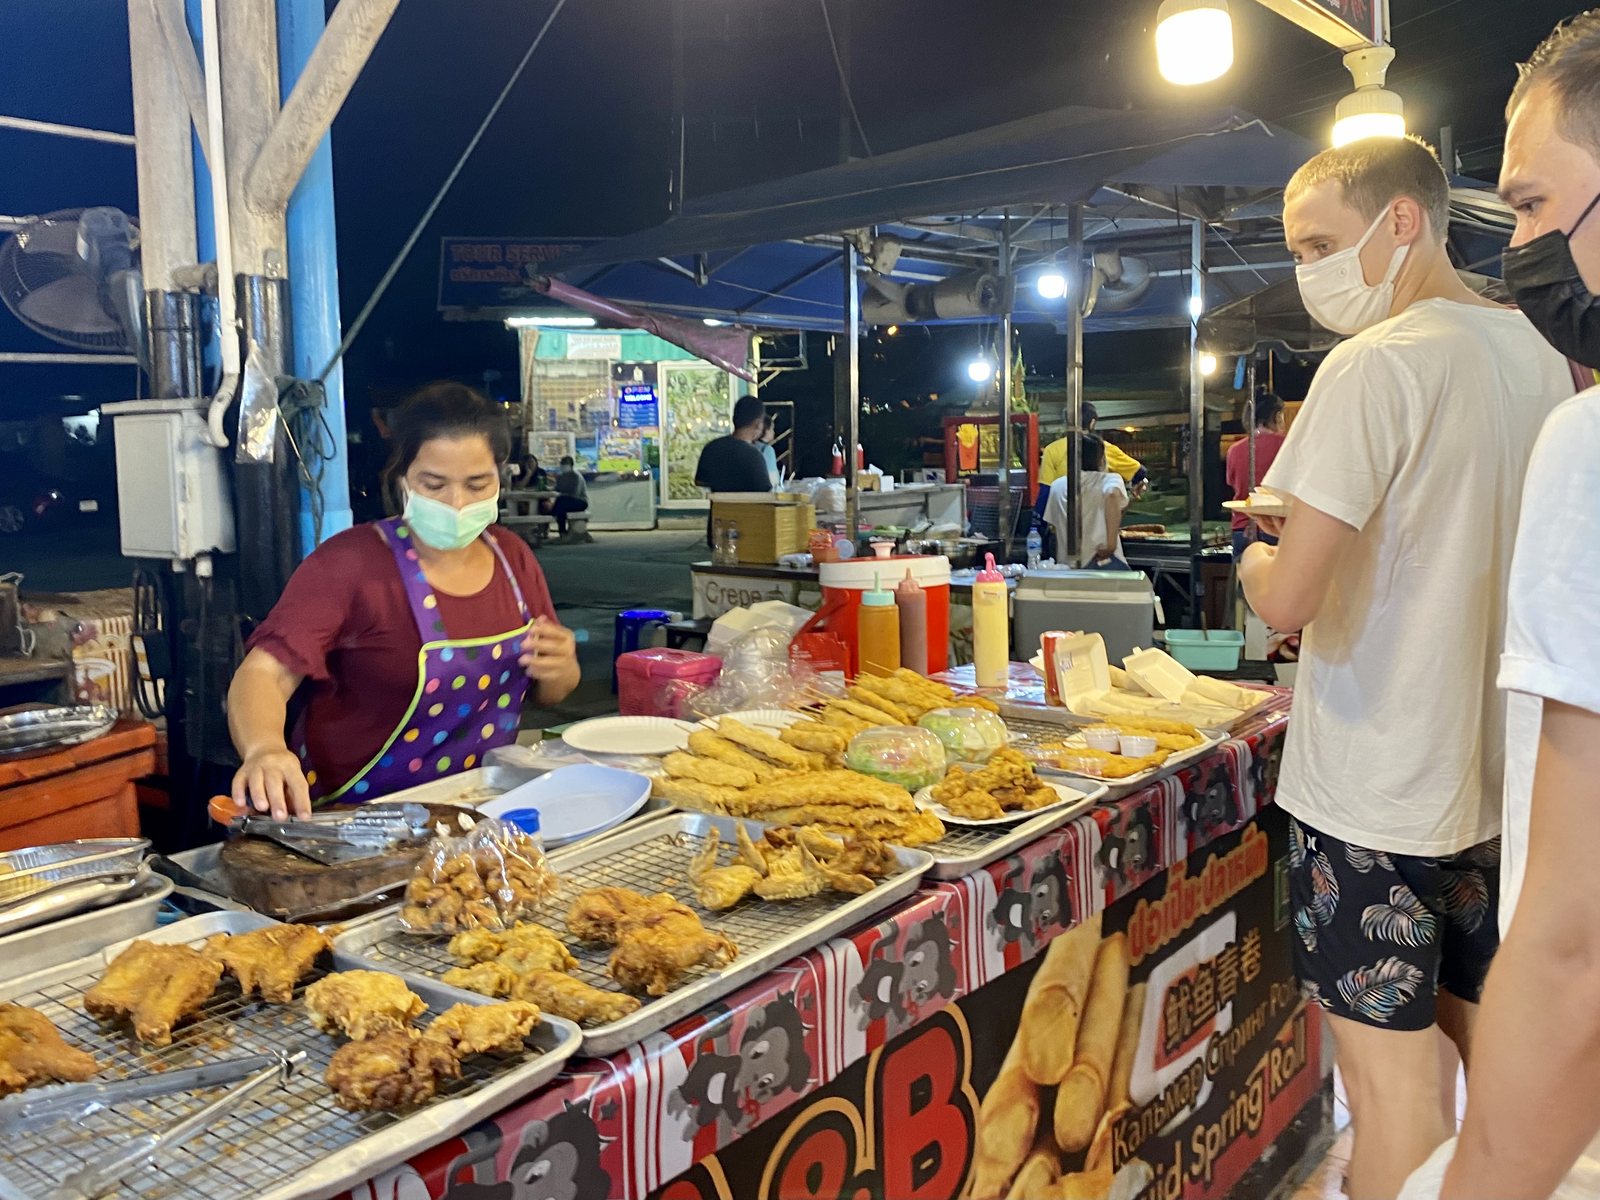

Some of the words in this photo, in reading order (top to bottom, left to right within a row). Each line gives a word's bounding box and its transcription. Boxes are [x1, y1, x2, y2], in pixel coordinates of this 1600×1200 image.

[705, 581, 762, 607] Crepe
[1191, 1077, 1264, 1182] Spring
[1270, 1011, 1306, 1095] Roll
